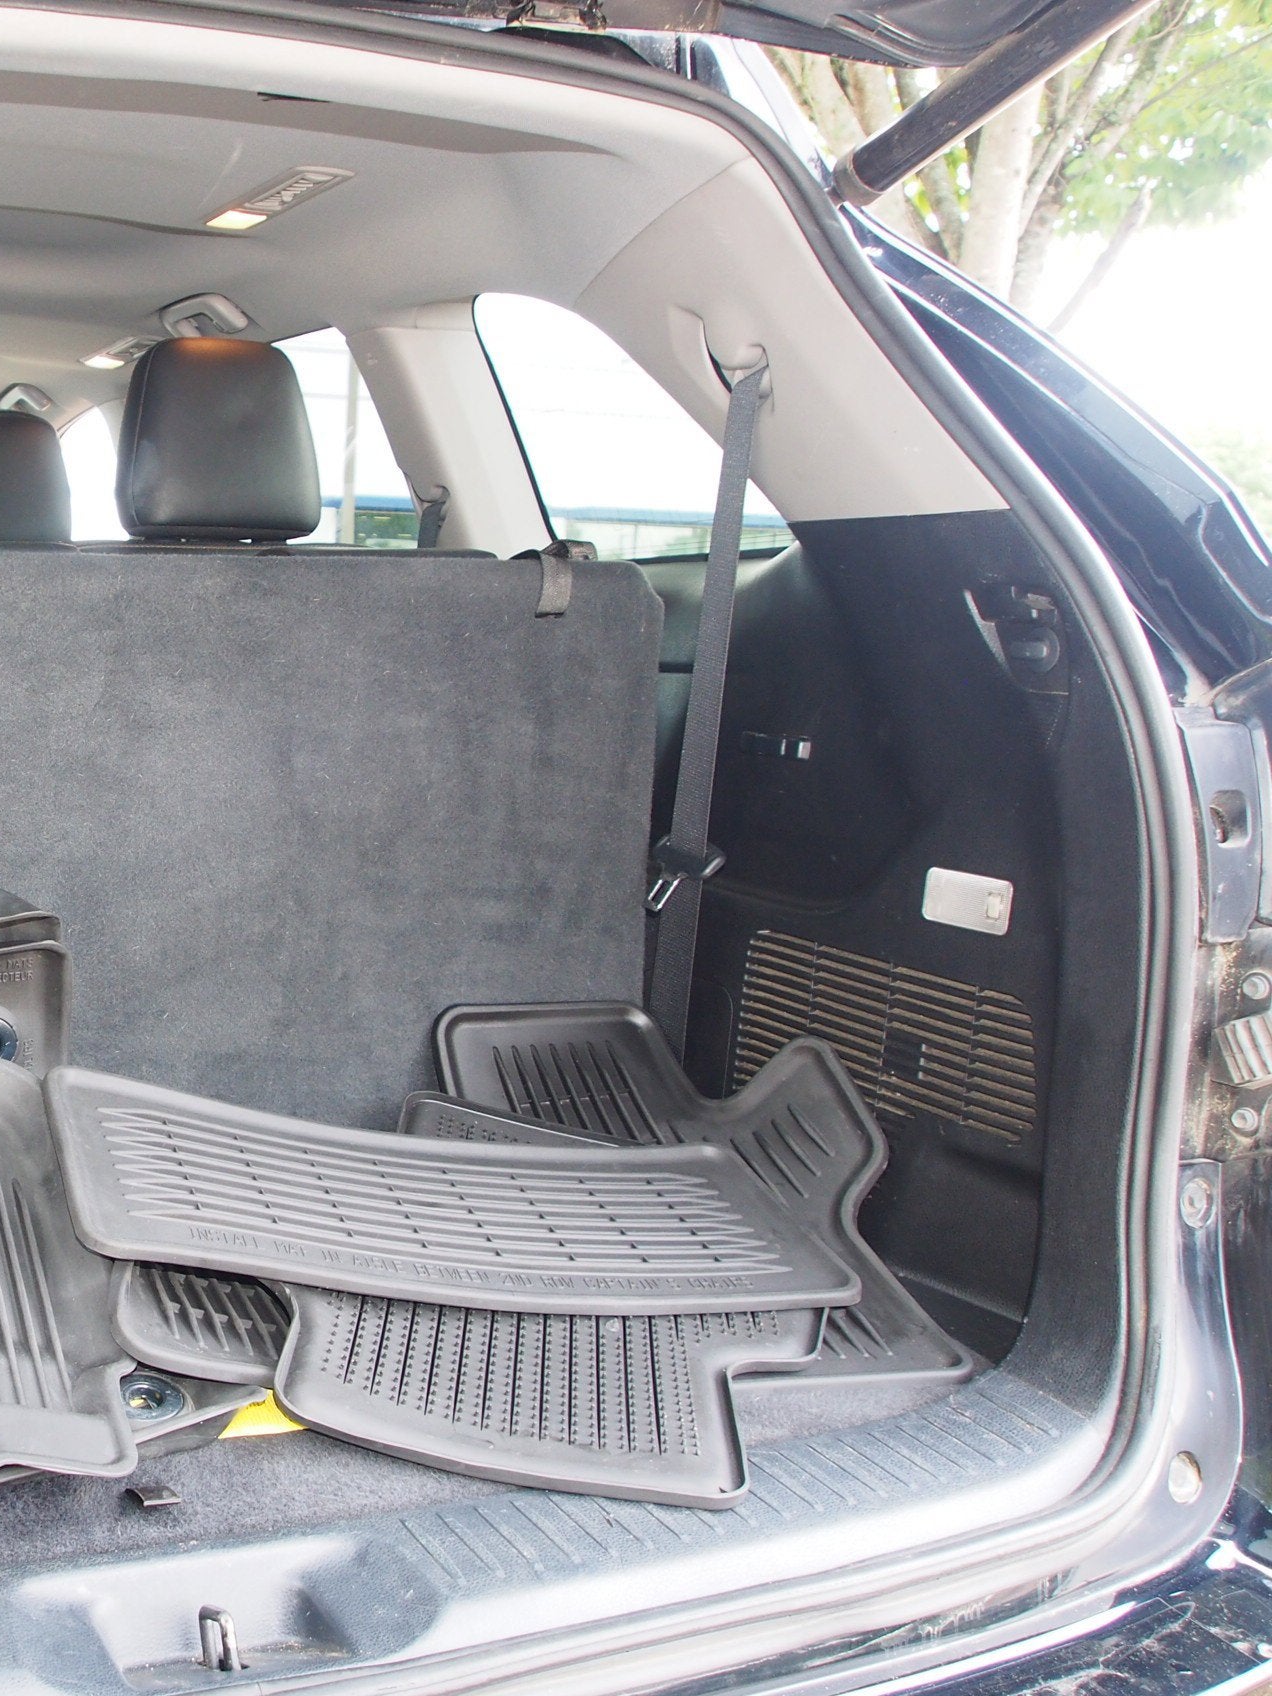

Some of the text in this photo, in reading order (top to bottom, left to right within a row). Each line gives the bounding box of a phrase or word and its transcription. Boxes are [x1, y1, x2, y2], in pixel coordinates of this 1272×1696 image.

[188, 1226, 262, 1249] INSTALL
[352, 1254, 404, 1273] AISLE
[413, 1262, 490, 1283] BETWEEN
[498, 1272, 532, 1287] 2ND
[540, 1275, 575, 1289] ROW
[689, 1275, 753, 1290] CHAIRS
